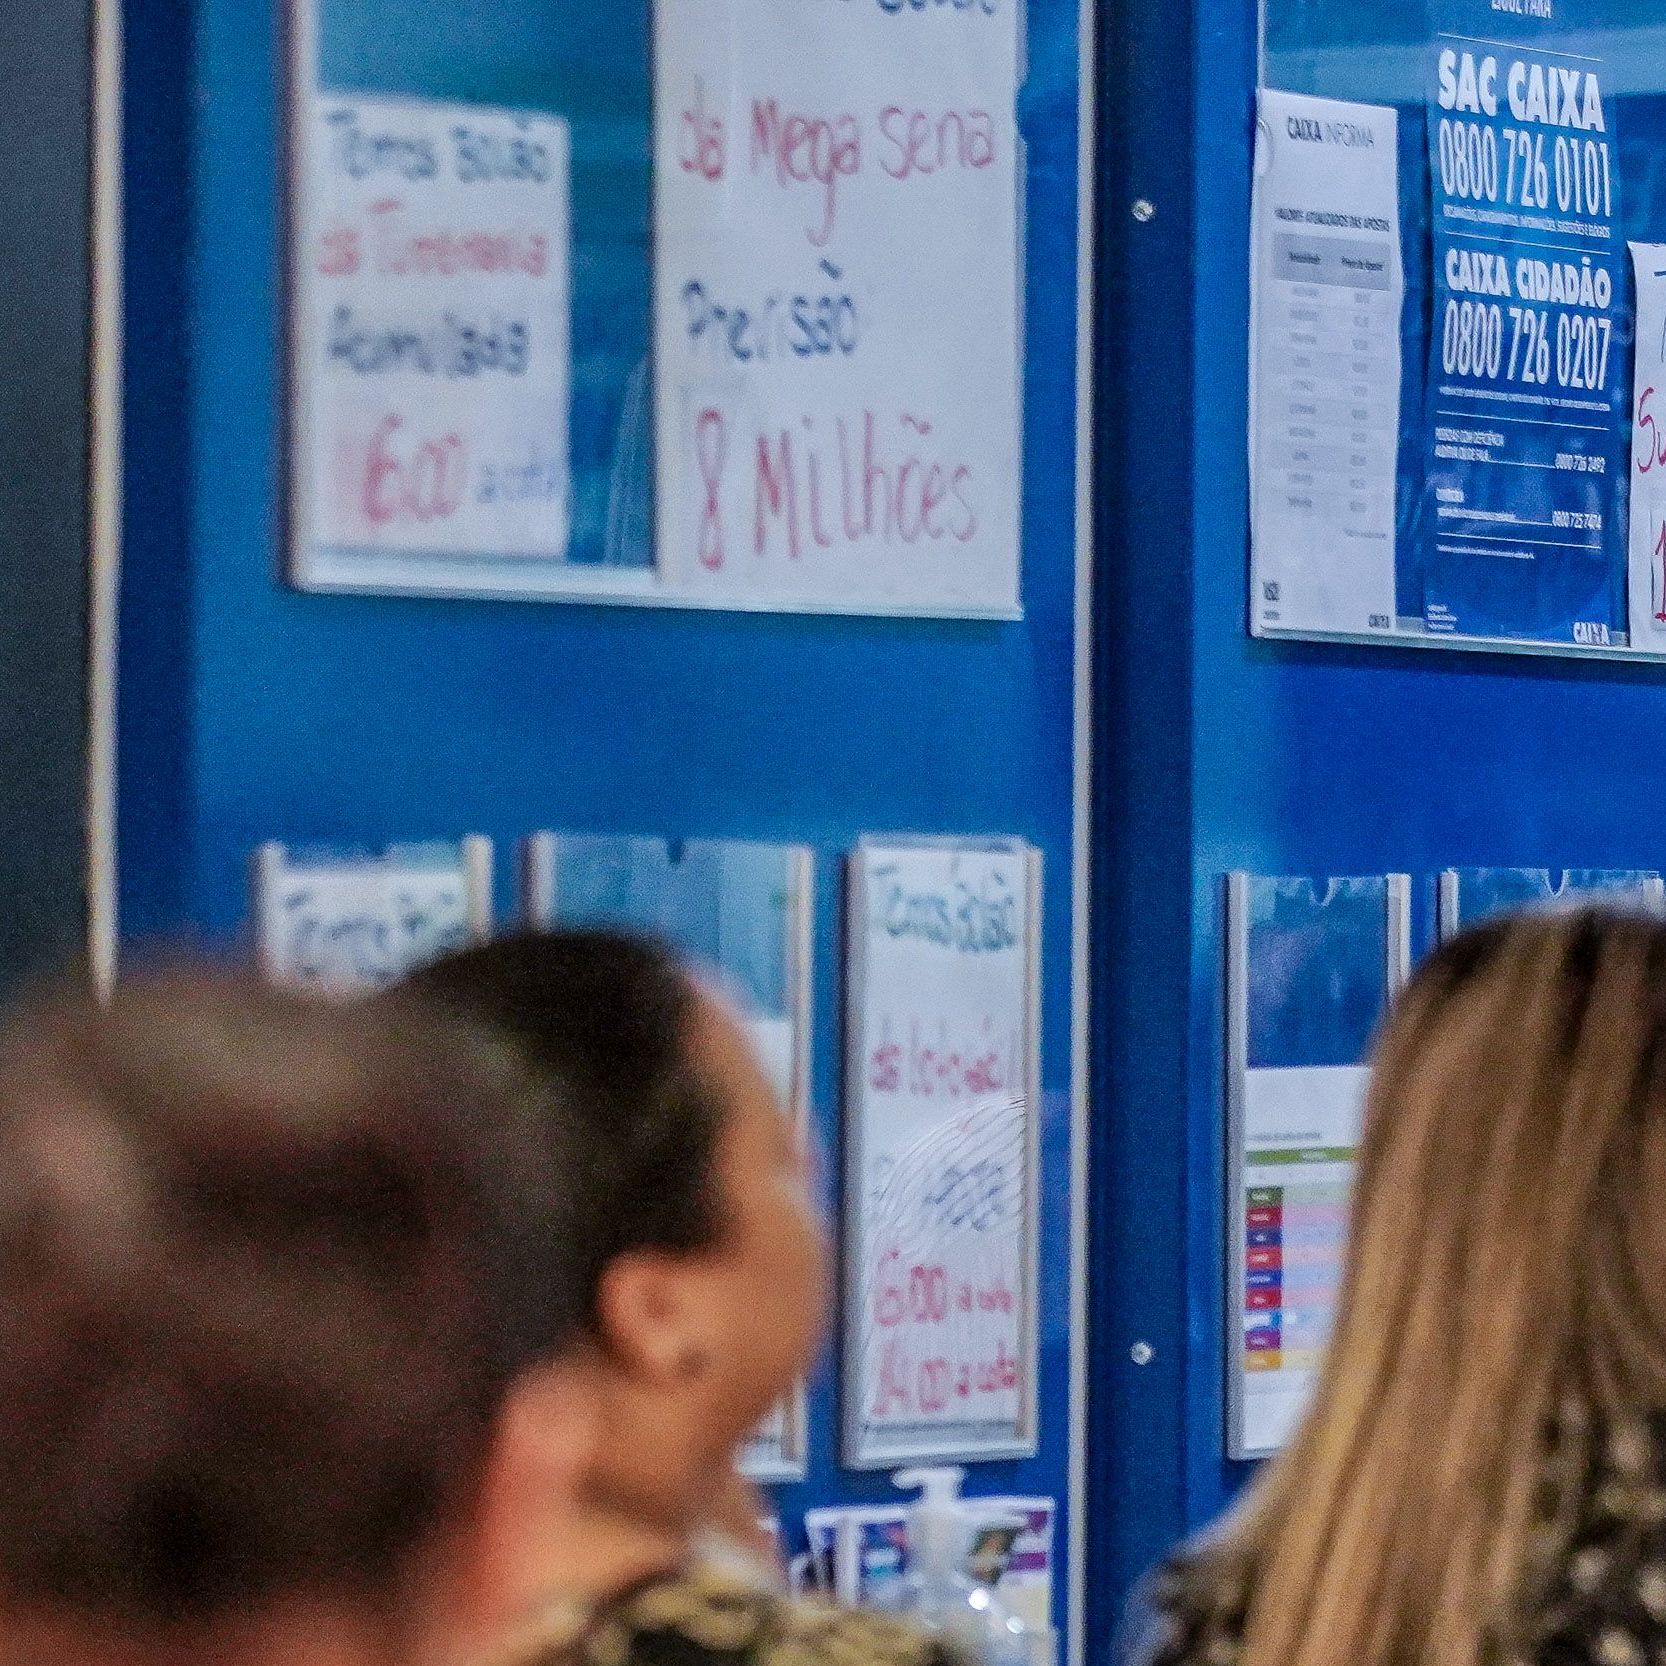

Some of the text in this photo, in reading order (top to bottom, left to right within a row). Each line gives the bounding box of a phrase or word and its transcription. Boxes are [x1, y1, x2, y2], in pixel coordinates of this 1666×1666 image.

[1288, 115, 1374, 149] CAIXA INFORMA
[1439, 47, 1606, 133] SAC CAIXA
[749, 95, 861, 248] Mega
[1440, 118, 1498, 202] 0800
[1502, 128, 1549, 209] 726
[1554, 136, 1611, 217] 0101
[1445, 247, 1611, 309] CAIXA CIDADÃO
[1442, 298, 1612, 391] 0800 726 0207
[693, 406, 980, 572] 8 Milhões
